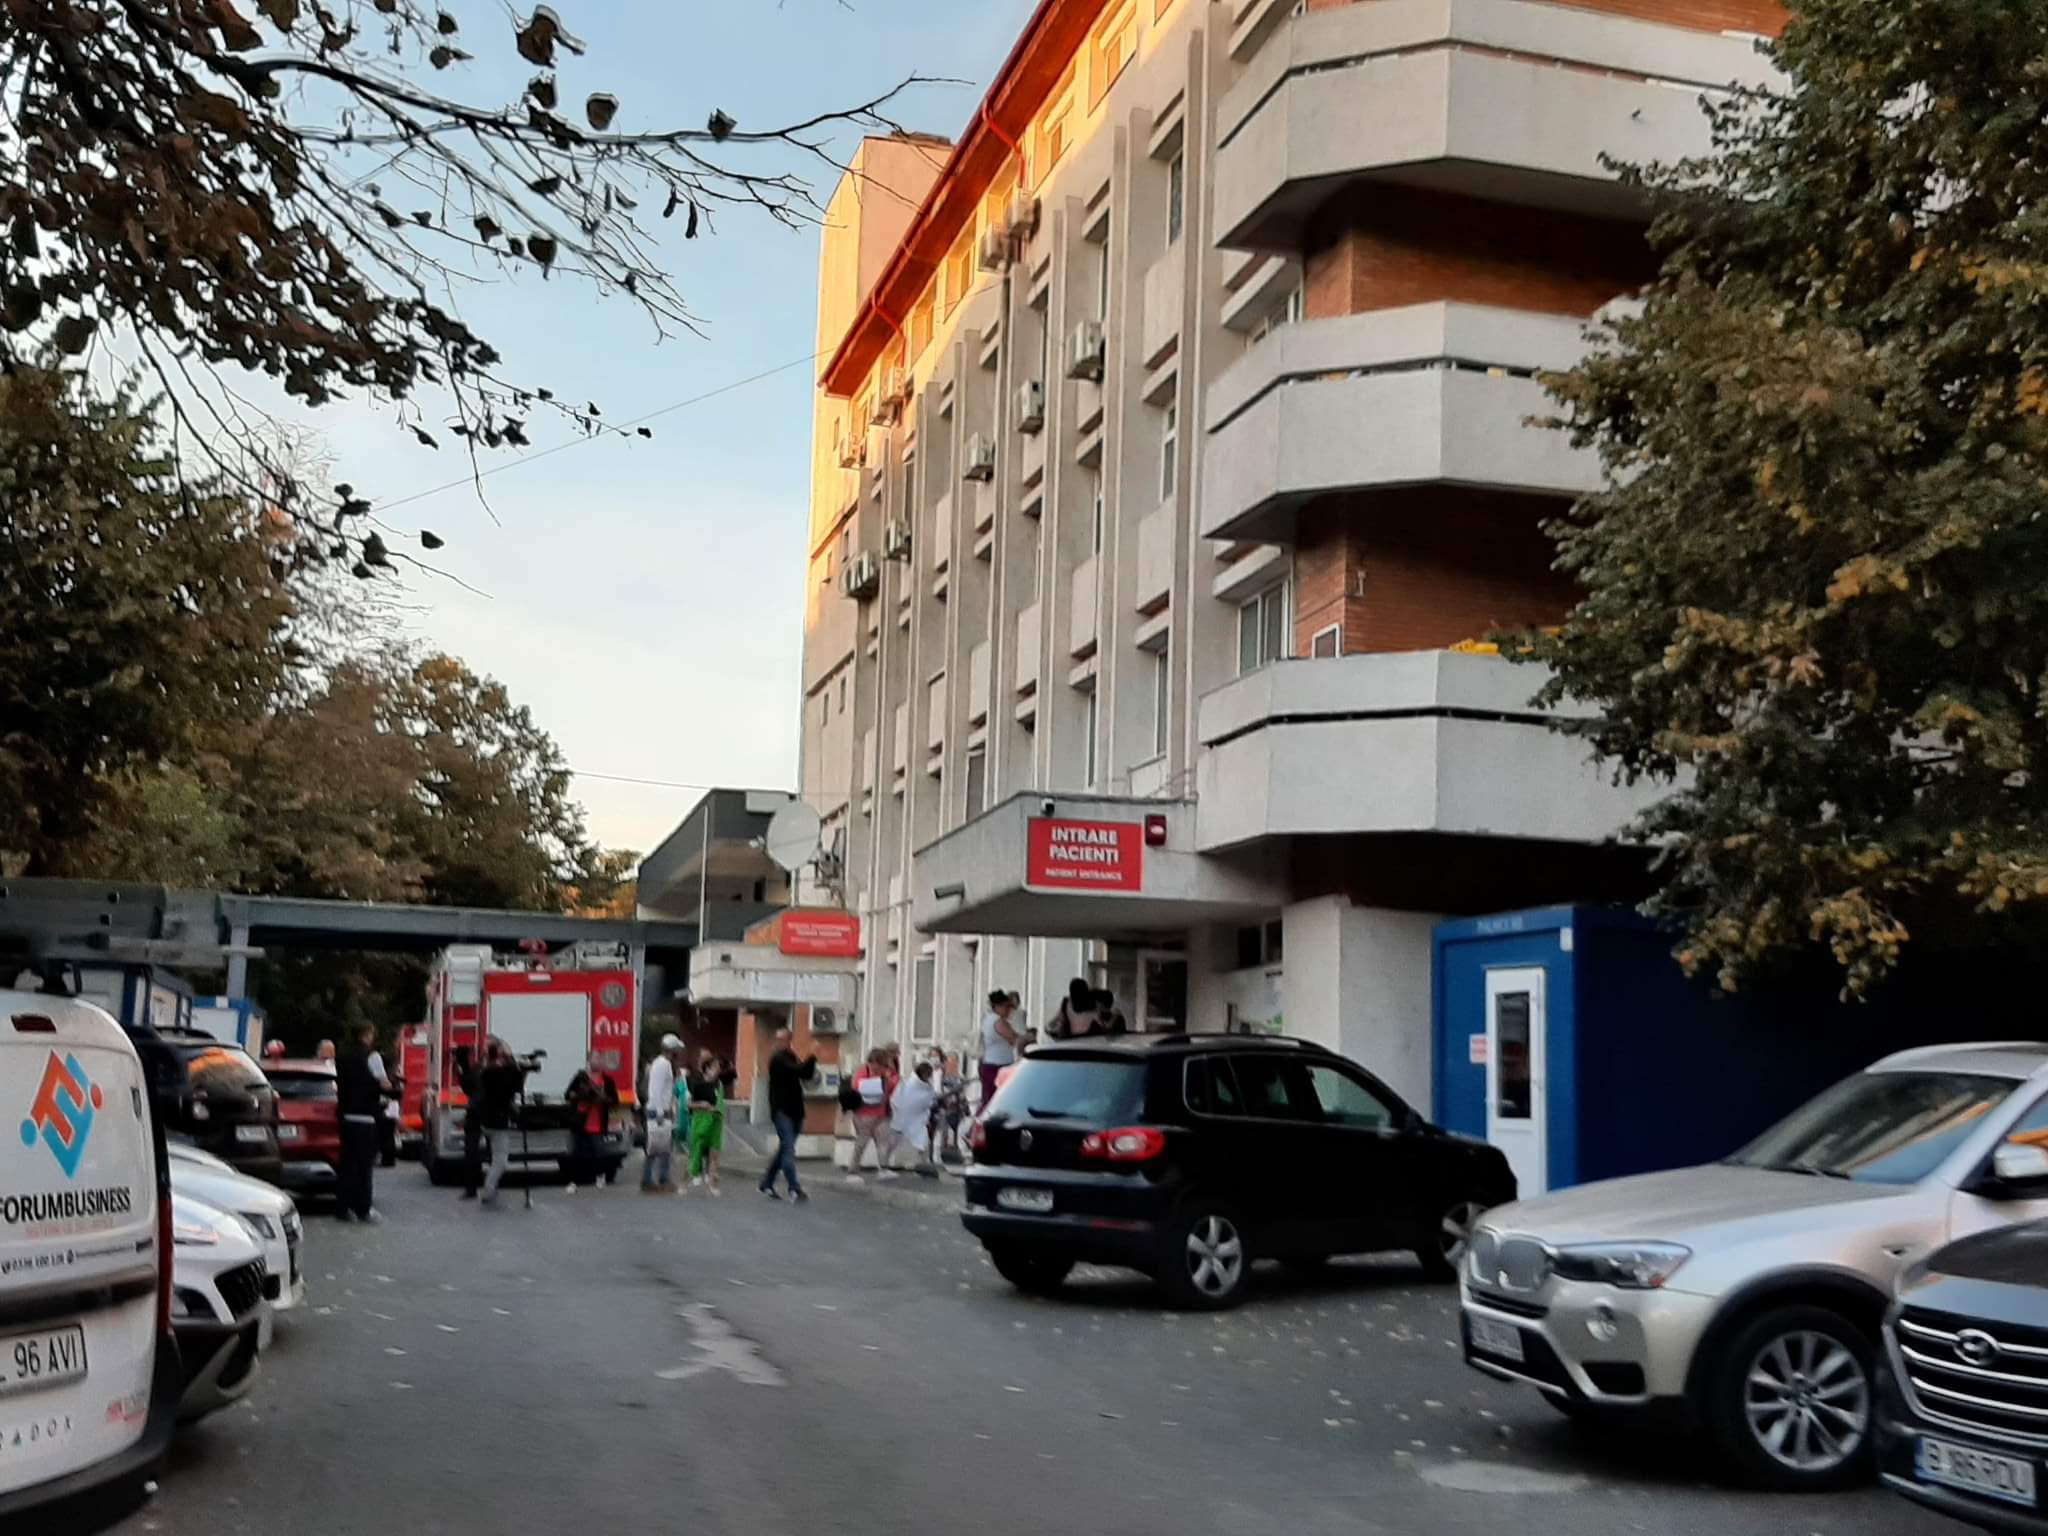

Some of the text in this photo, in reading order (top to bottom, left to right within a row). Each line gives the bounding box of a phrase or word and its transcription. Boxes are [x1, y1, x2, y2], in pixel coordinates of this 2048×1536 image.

[1051, 826, 1117, 845] INTRARE
[1049, 843, 1120, 866] PACIENȚI
[14, 1334, 77, 1378] 96 AVI
